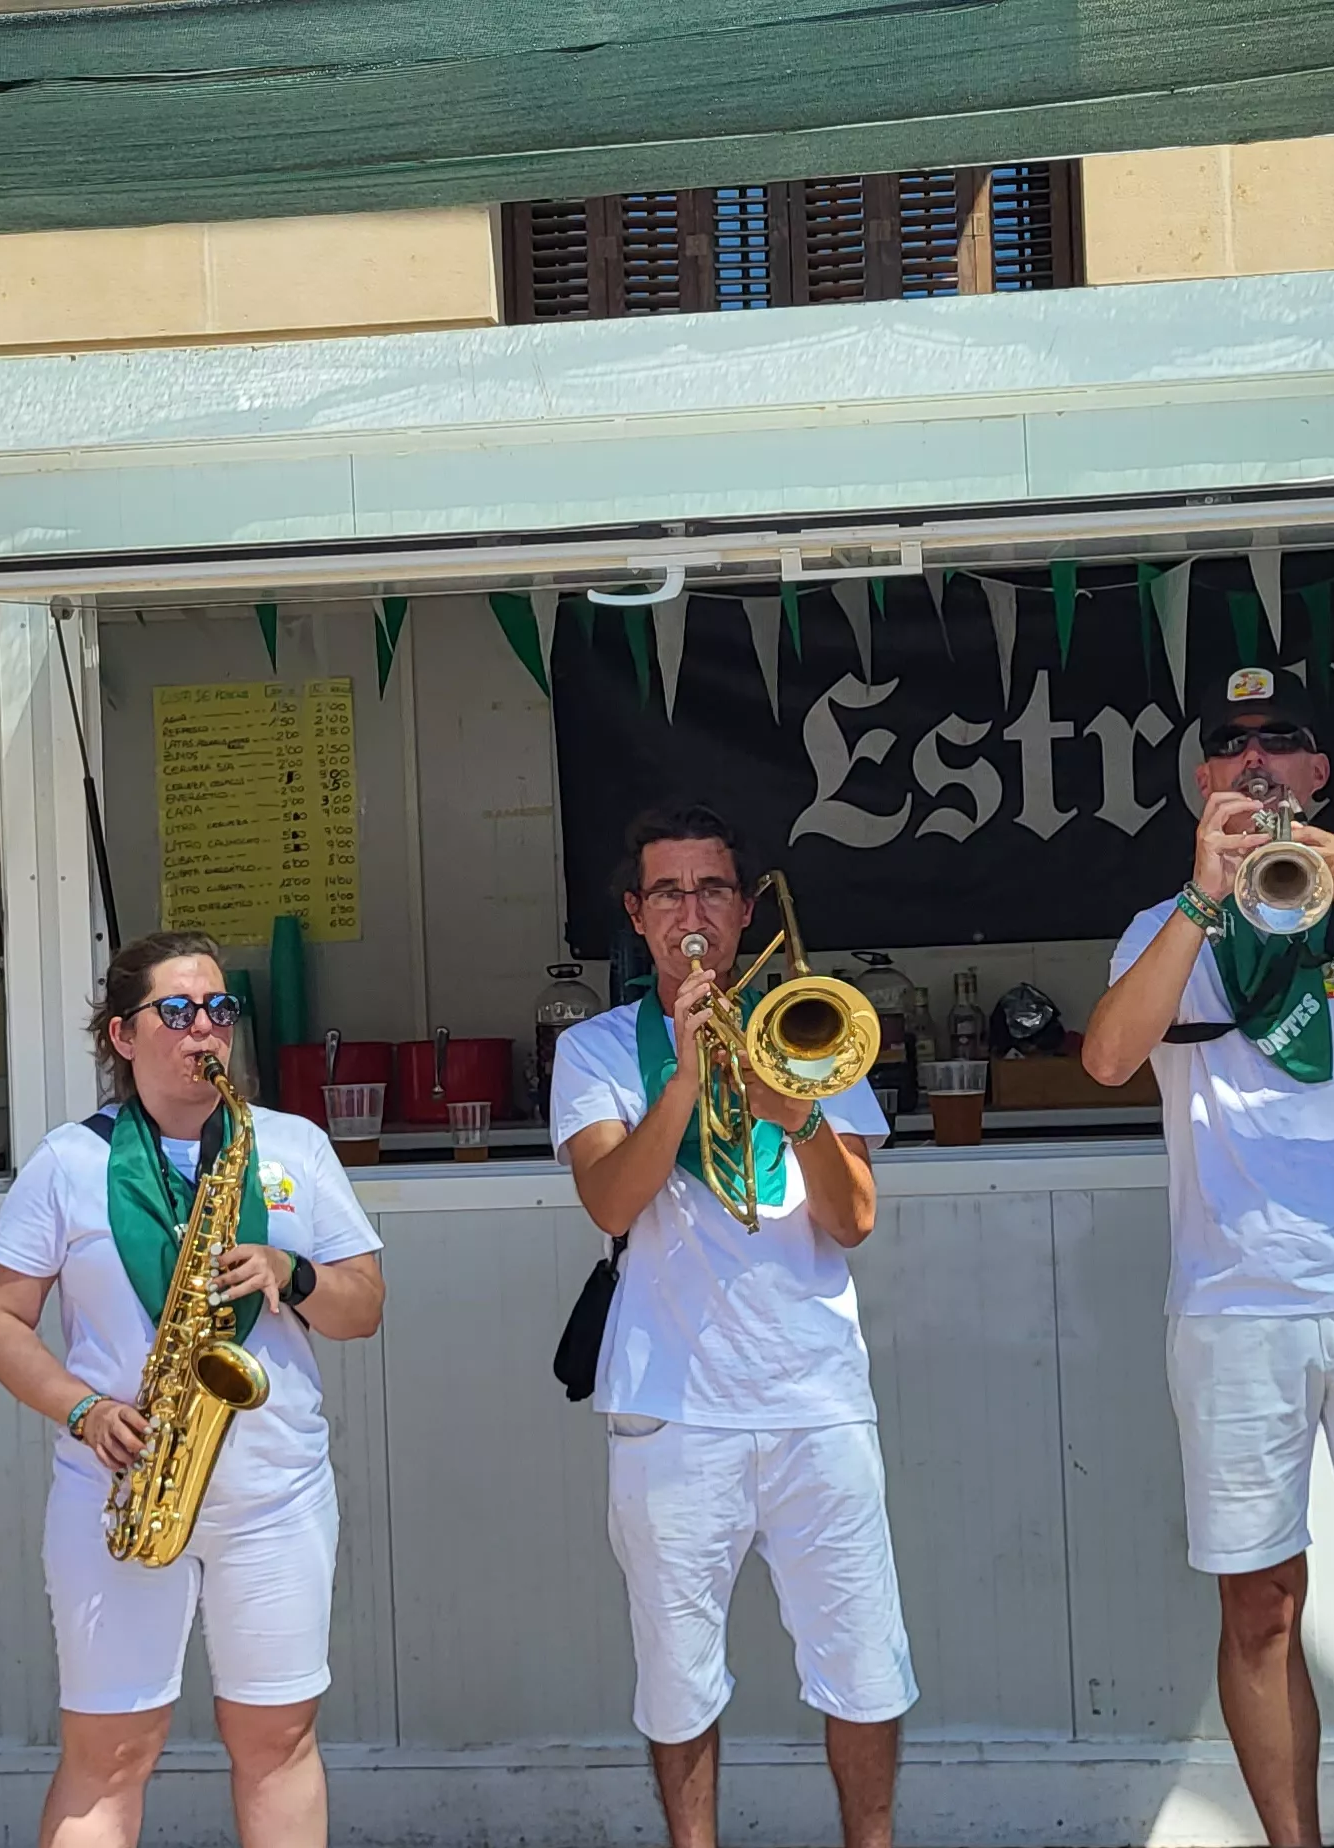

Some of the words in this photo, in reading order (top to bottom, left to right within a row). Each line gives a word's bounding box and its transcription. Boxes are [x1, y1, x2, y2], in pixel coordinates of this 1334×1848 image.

[314, 714, 349, 726] 2'00
[315, 726, 351, 737] 2'50
[276, 744, 303, 757] 2'00
[317, 743, 350, 755] 2'50
